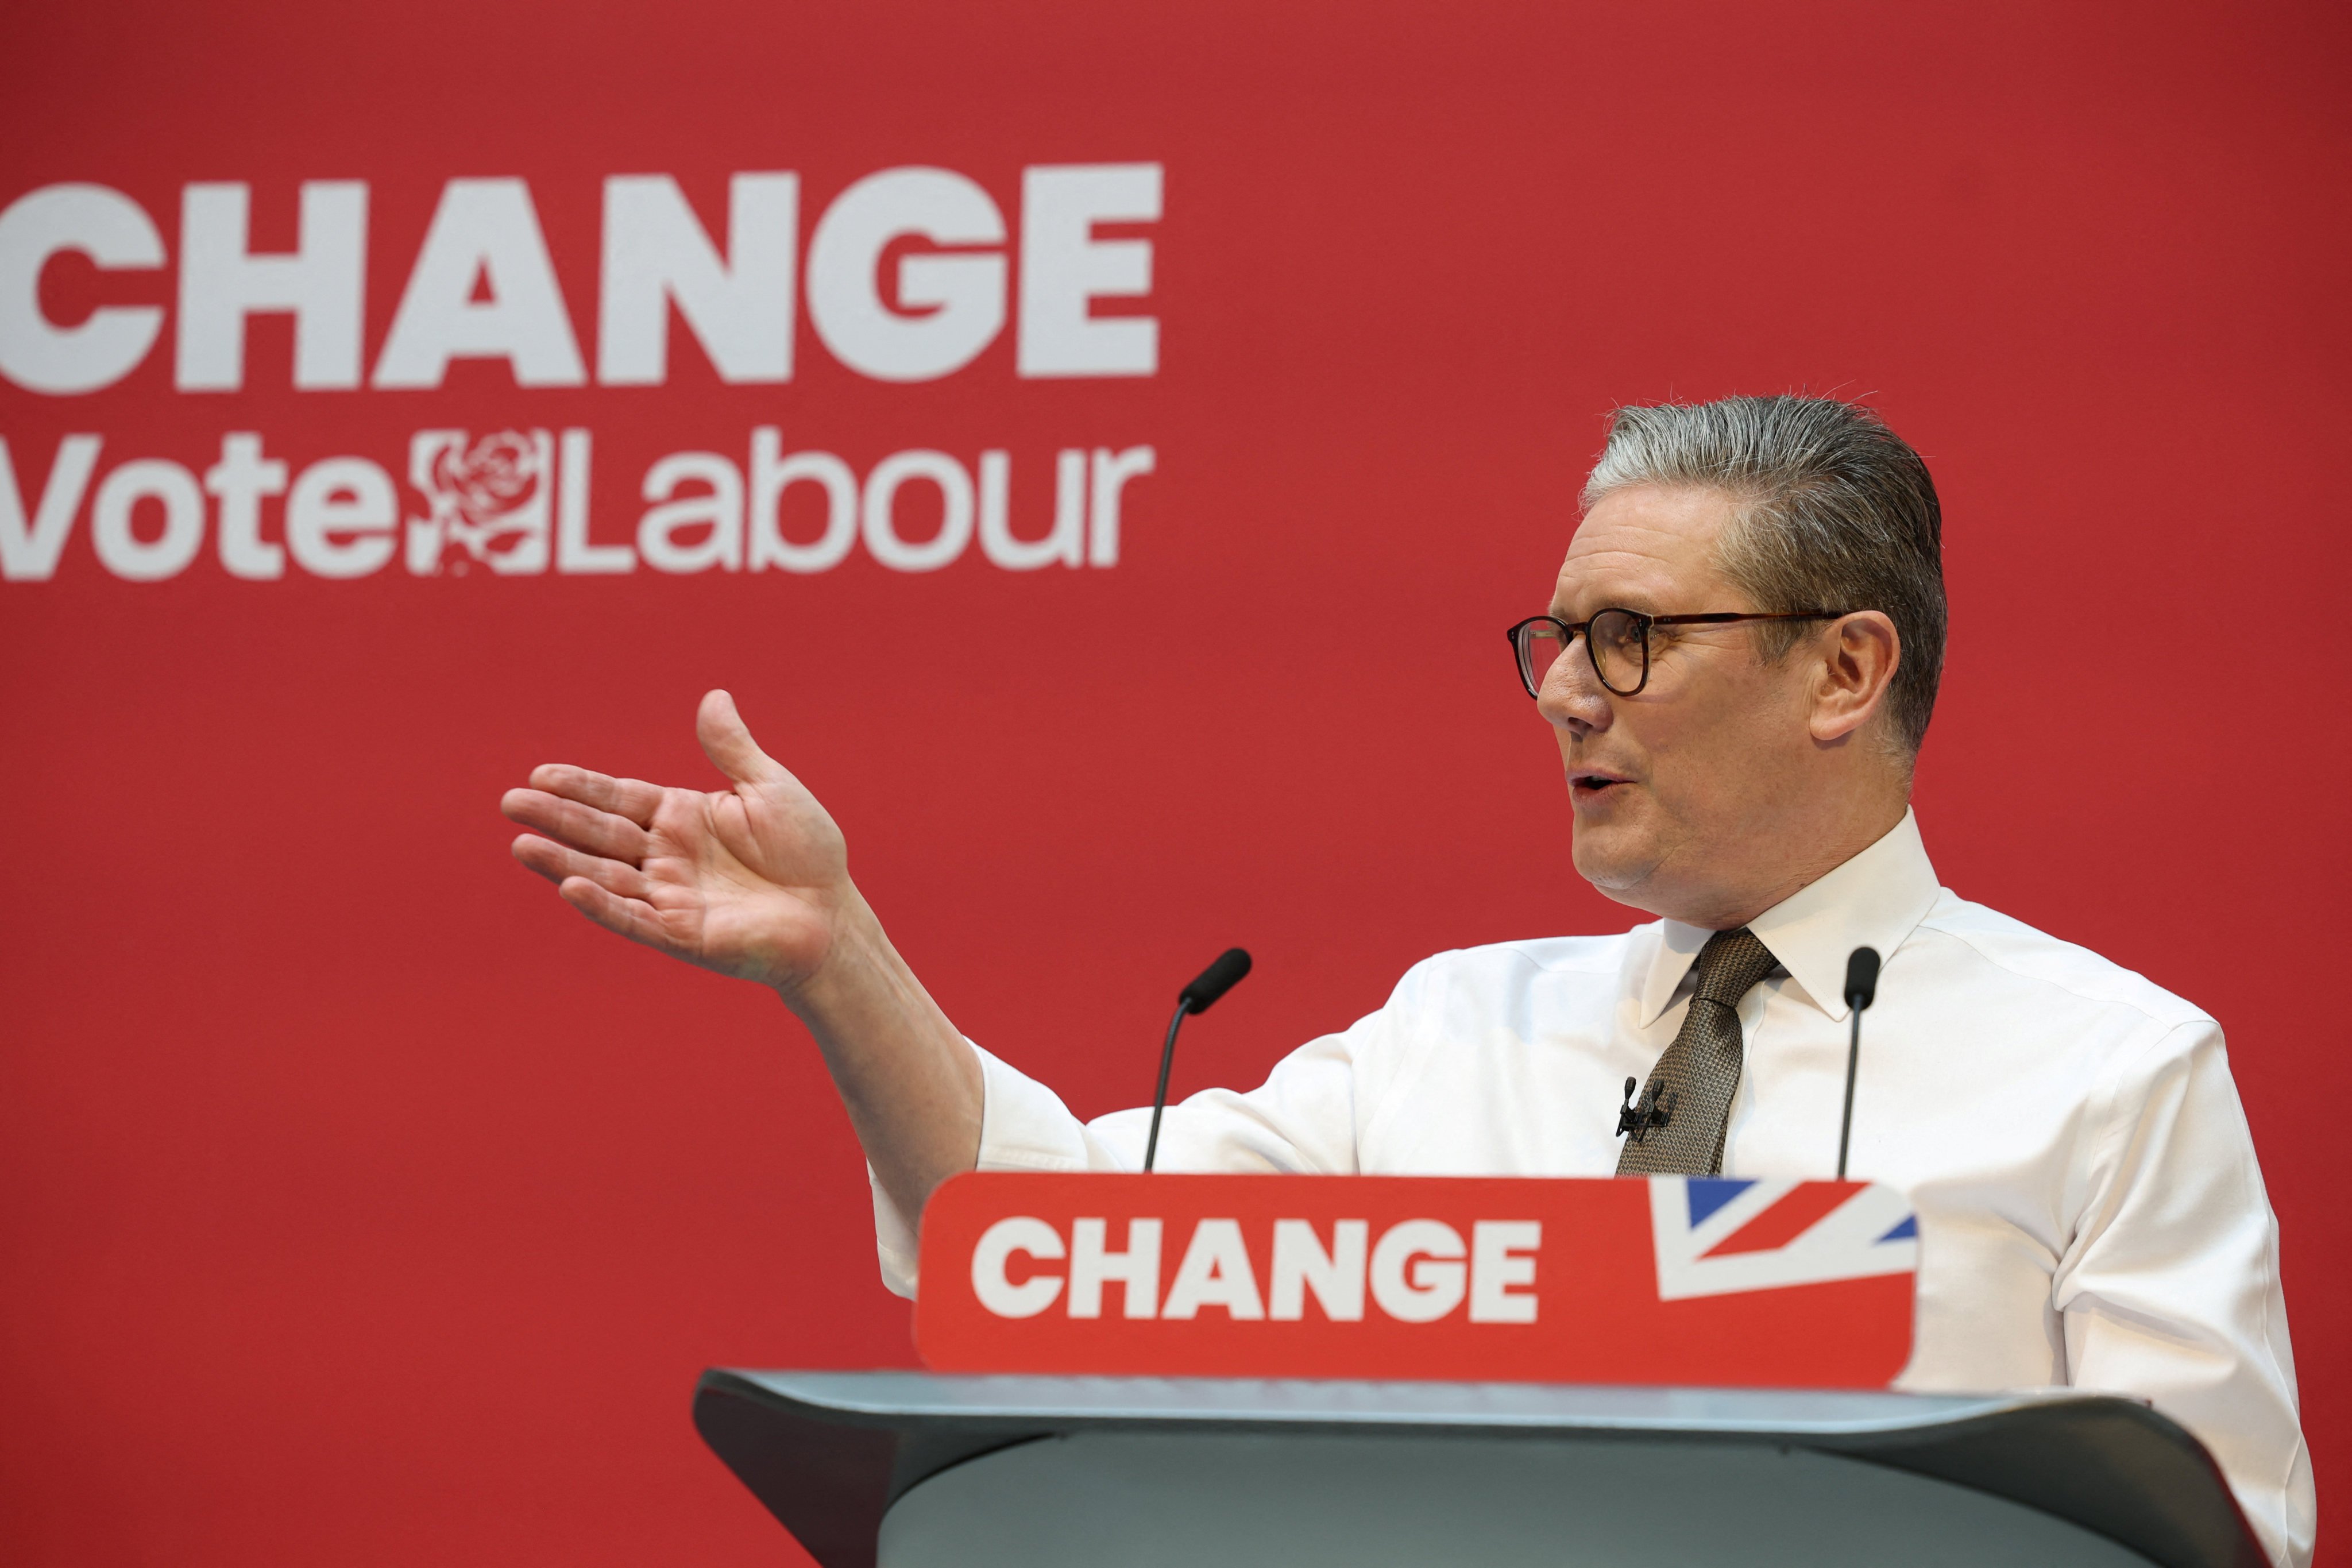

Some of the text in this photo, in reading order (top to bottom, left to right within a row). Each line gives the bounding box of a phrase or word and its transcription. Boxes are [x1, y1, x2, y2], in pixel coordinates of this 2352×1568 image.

[0, 163, 1163, 393] CHANGE
[0, 427, 1154, 580] Vote Labour
[971, 1216, 1542, 1324] CHANGE
